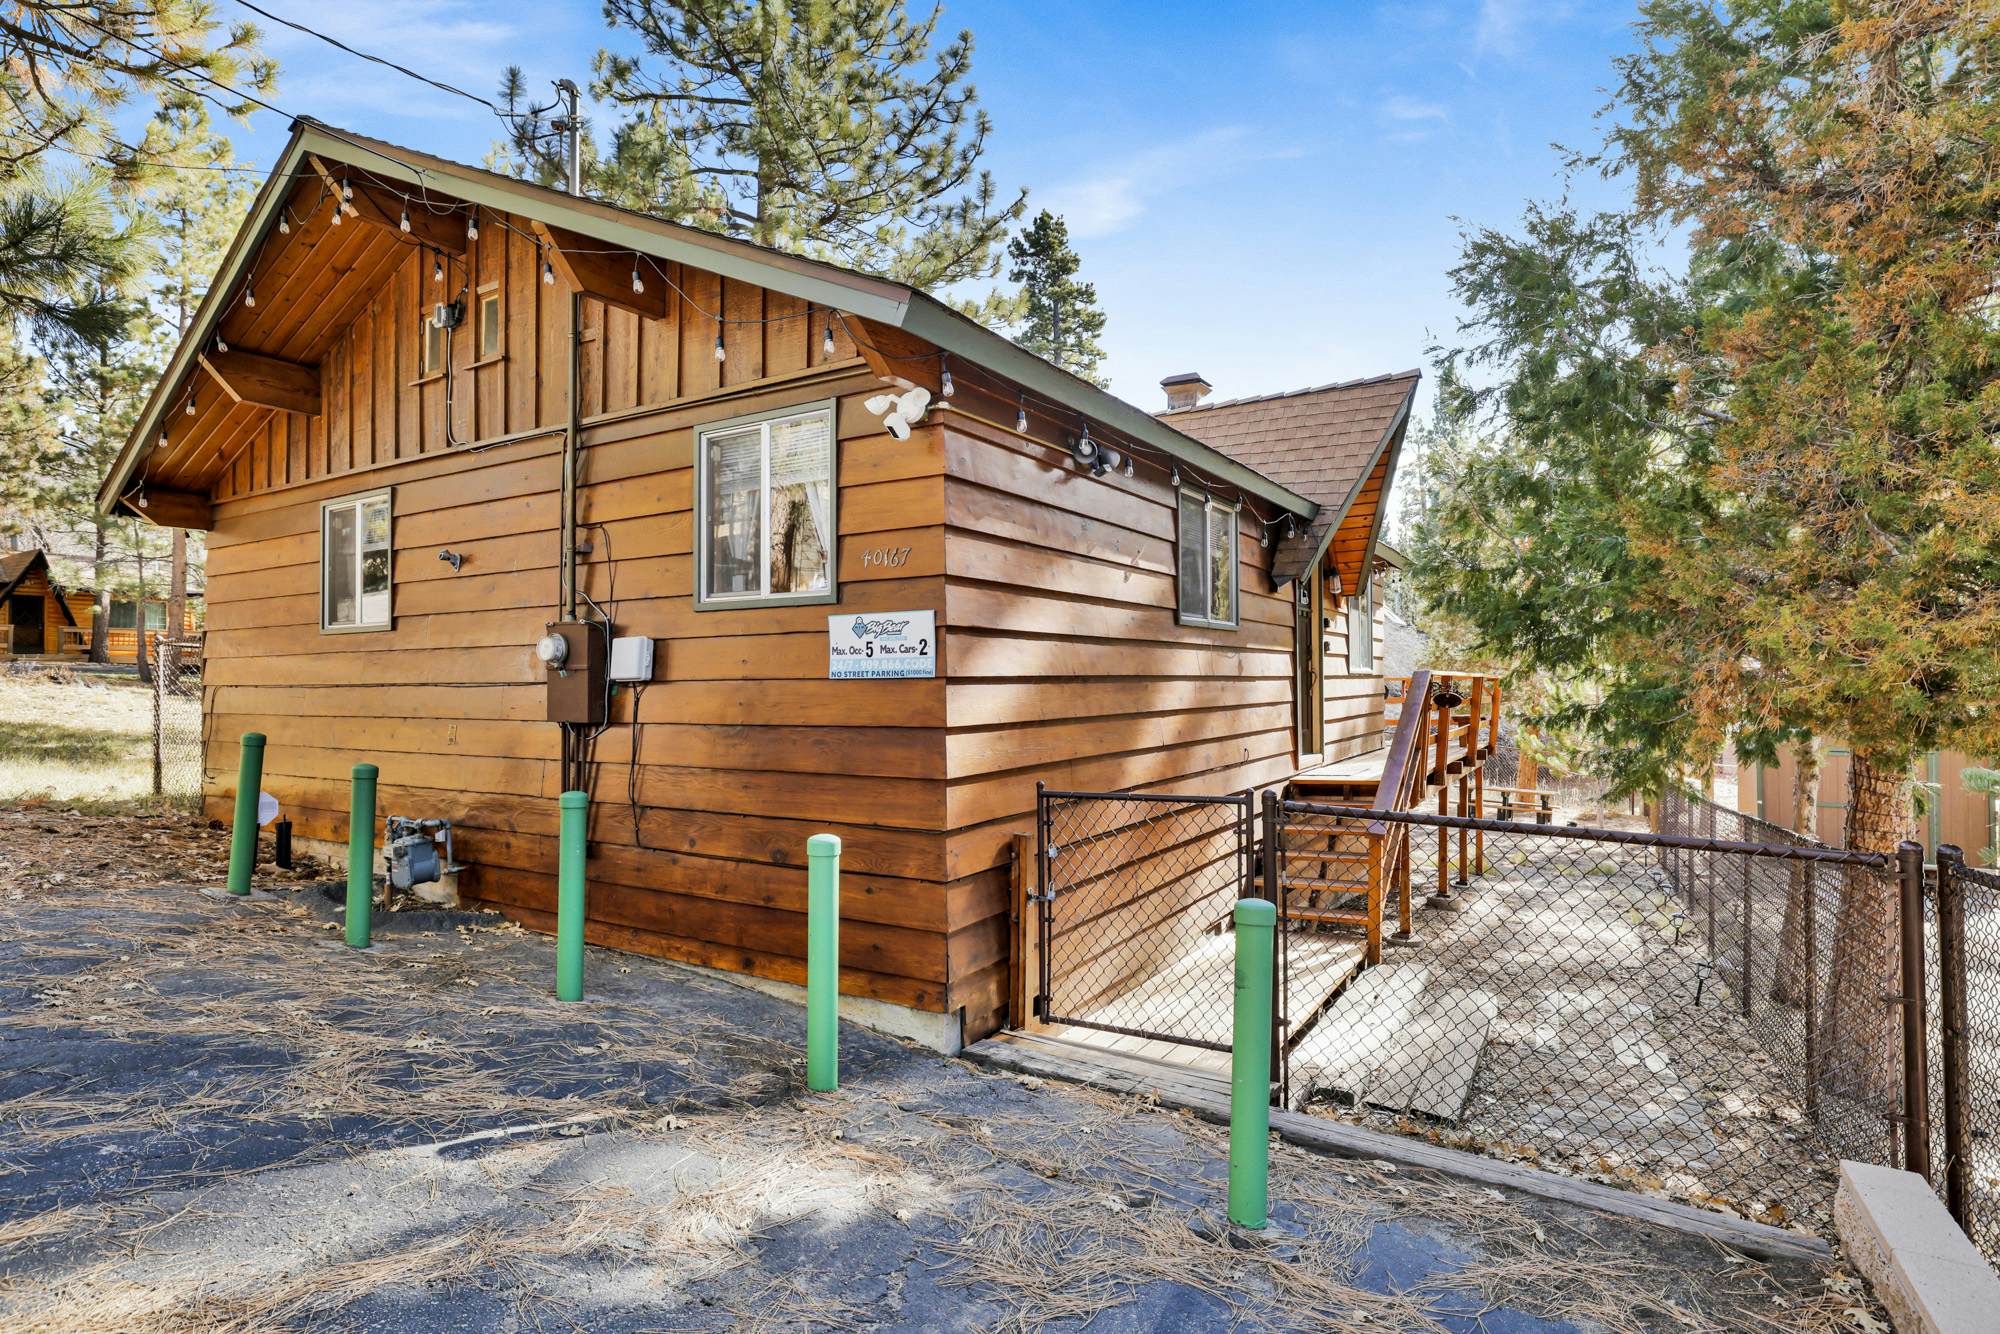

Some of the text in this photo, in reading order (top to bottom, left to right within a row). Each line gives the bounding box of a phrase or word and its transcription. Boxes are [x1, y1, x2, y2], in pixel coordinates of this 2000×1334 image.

[863, 546, 912, 568] 40167
[865, 619, 909, 639] Big Bear
[831, 646, 848, 656] Max.
[865, 641, 874, 658] 5
[880, 644, 897, 654] Max.
[919, 638, 928, 656] 2
[831, 670, 842, 678] NO
[844, 670, 869, 678] STREET
[871, 669, 905, 677] PARKING
